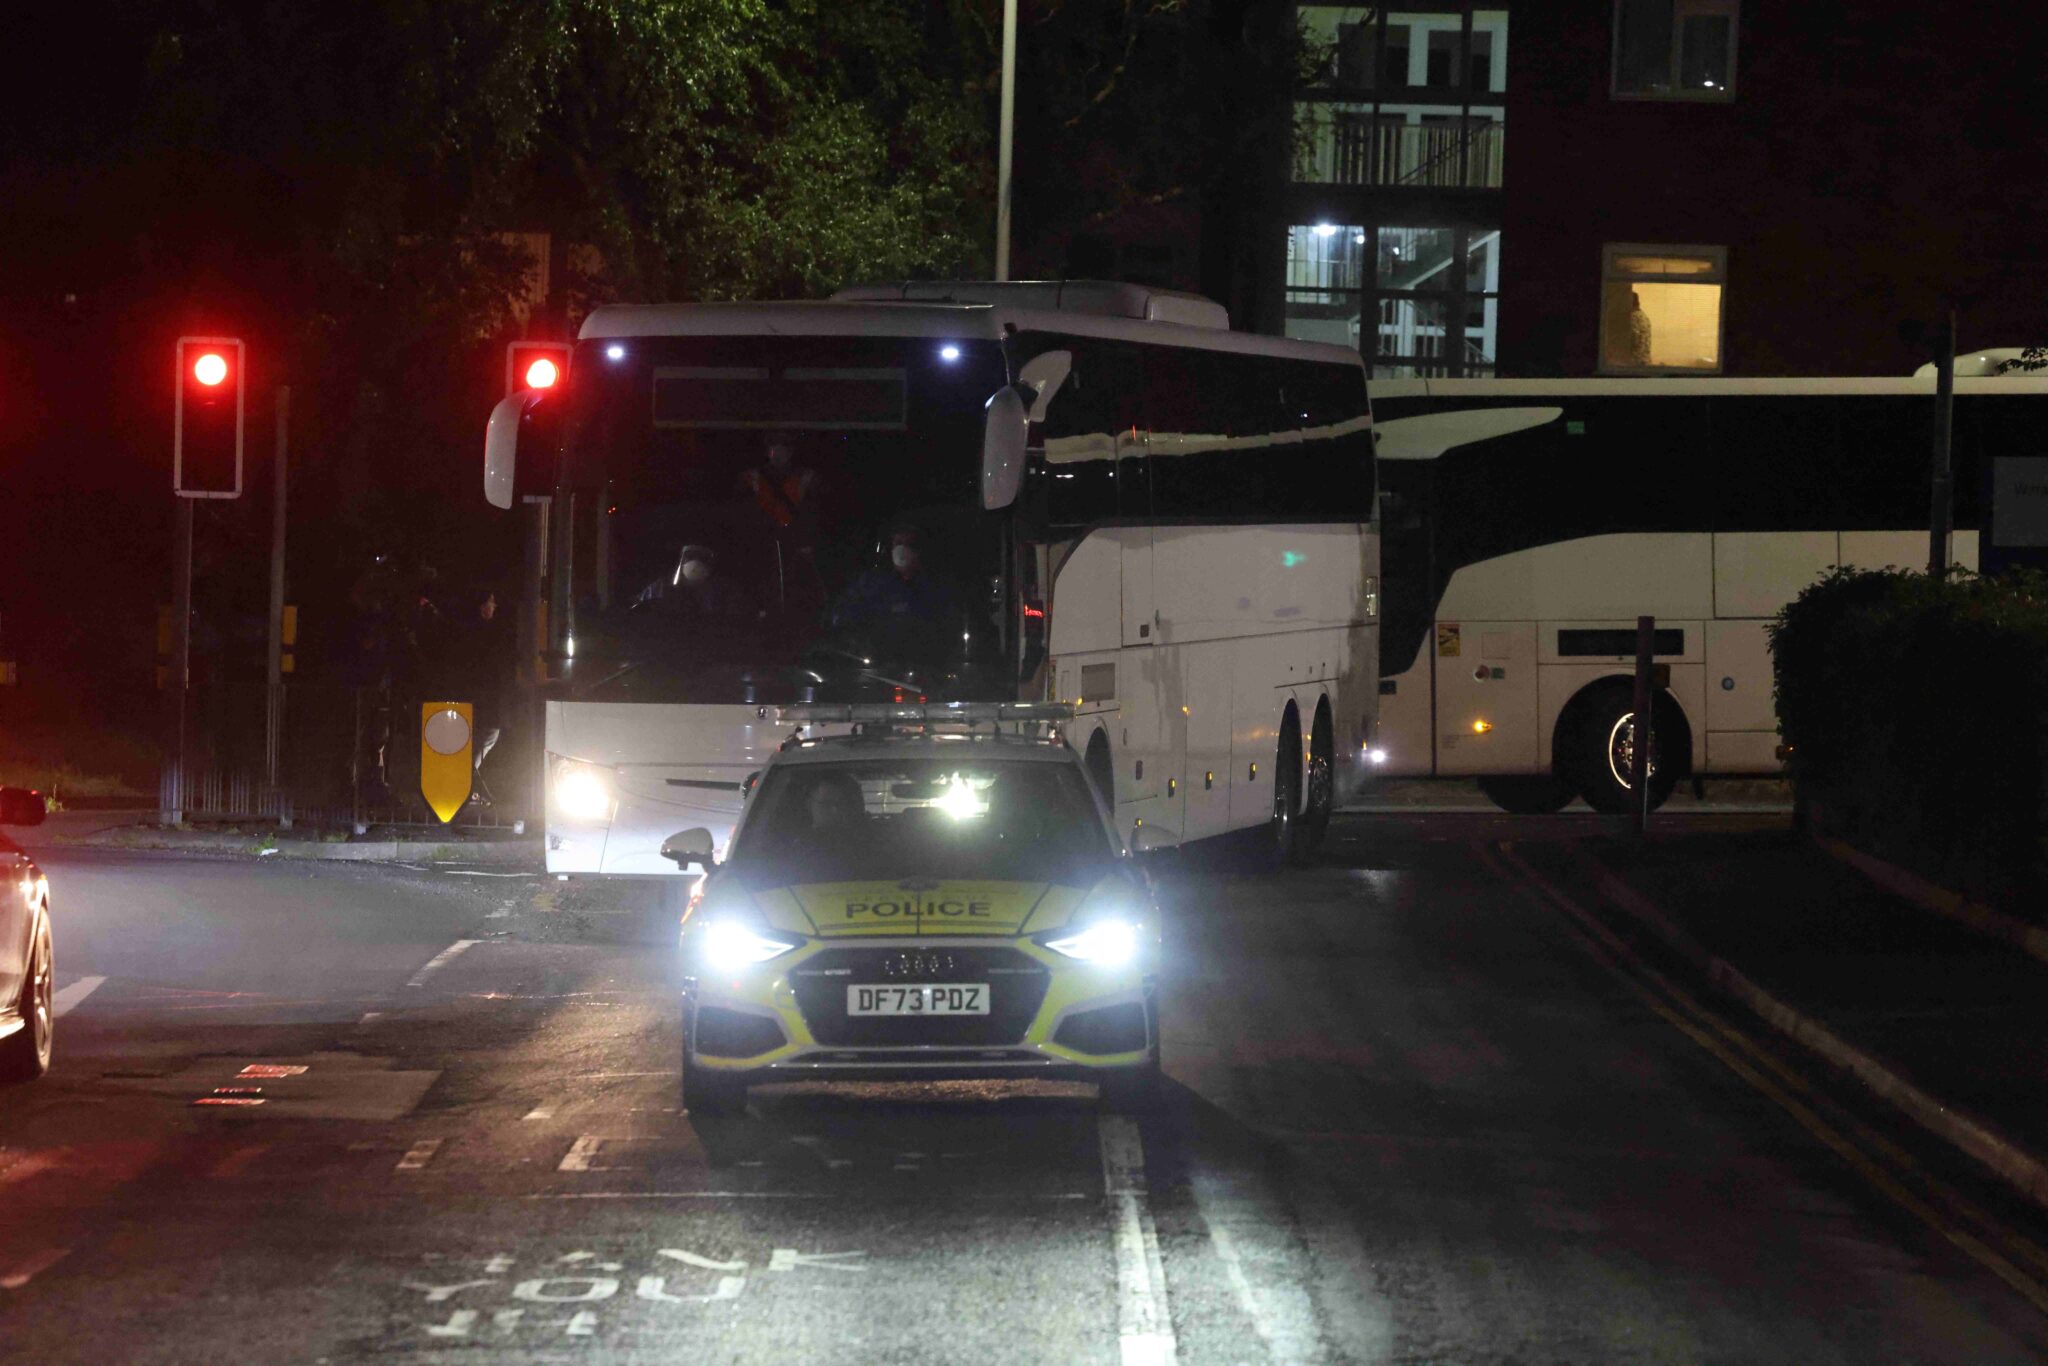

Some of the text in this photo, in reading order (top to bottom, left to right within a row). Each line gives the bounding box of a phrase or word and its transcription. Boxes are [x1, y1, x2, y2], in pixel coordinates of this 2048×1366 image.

[846, 901, 991, 918] POLICE
[858, 988, 980, 1011] DF73 PDZ
[400, 1276, 748, 1302] YOU
